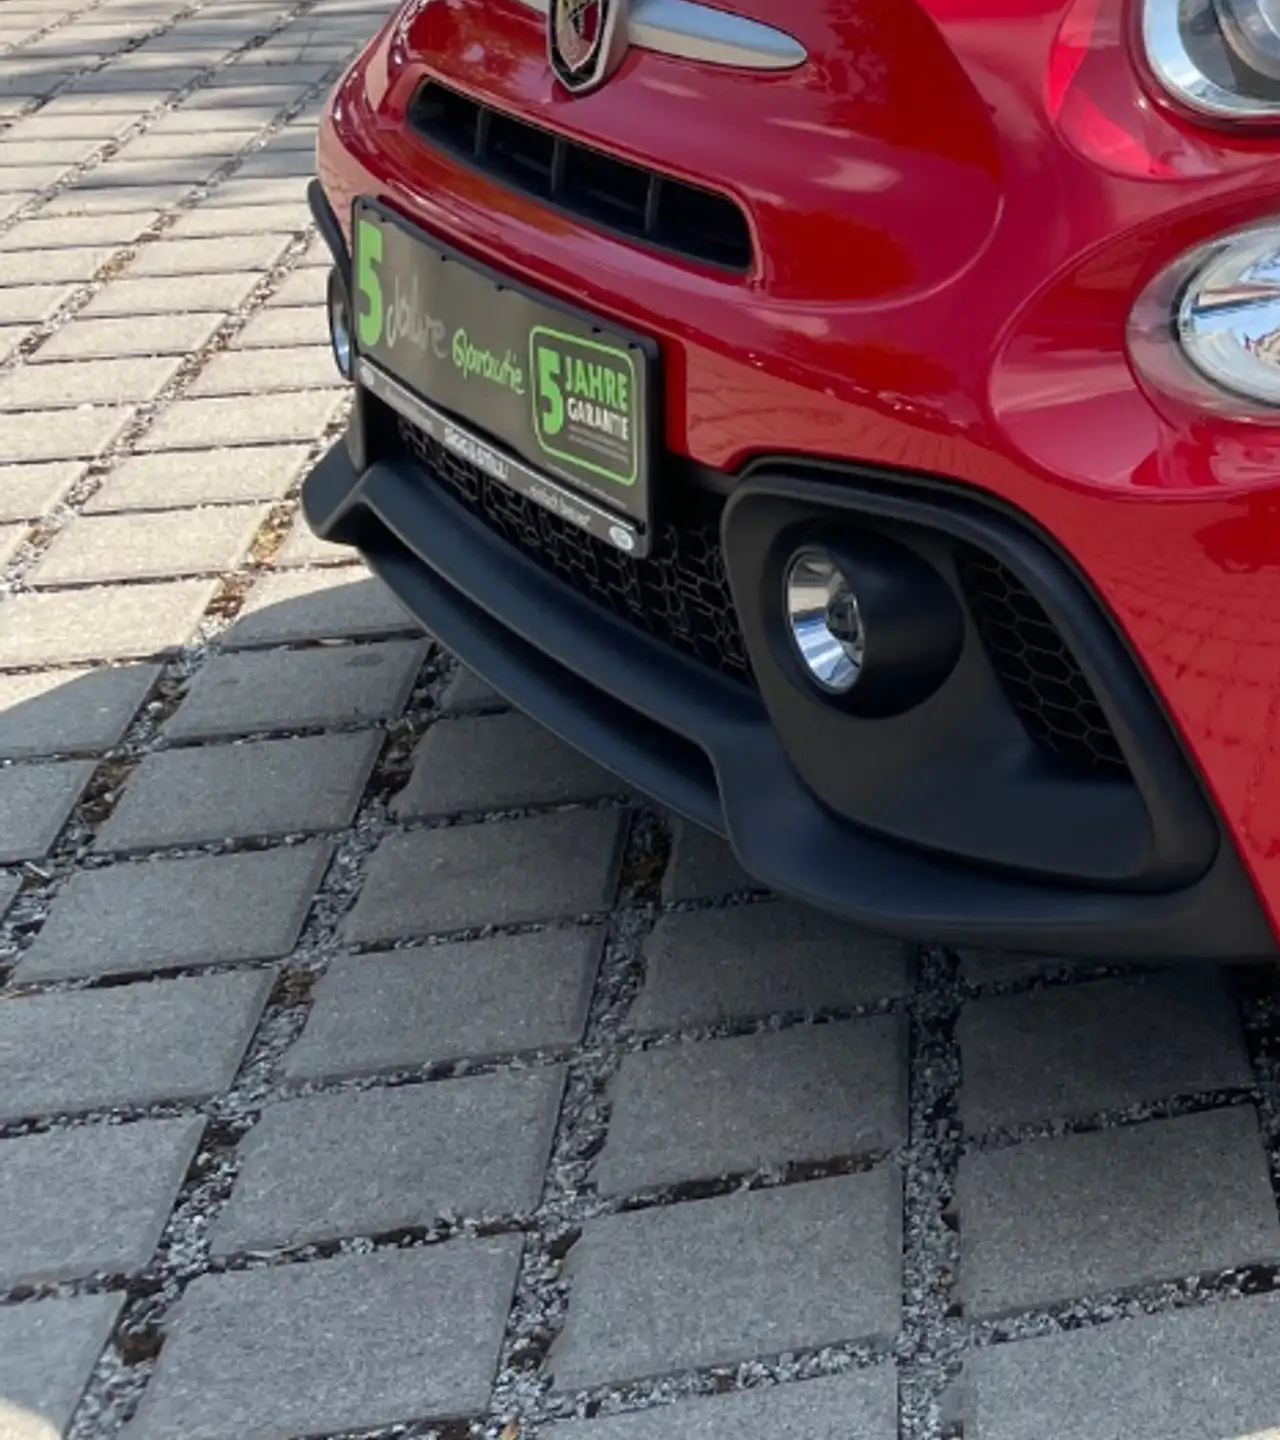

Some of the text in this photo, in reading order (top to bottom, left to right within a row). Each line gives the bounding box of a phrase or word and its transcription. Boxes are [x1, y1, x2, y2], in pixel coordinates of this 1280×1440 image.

[359, 219, 382, 347] 5
[538, 347, 629, 435] 5 JAHRE
